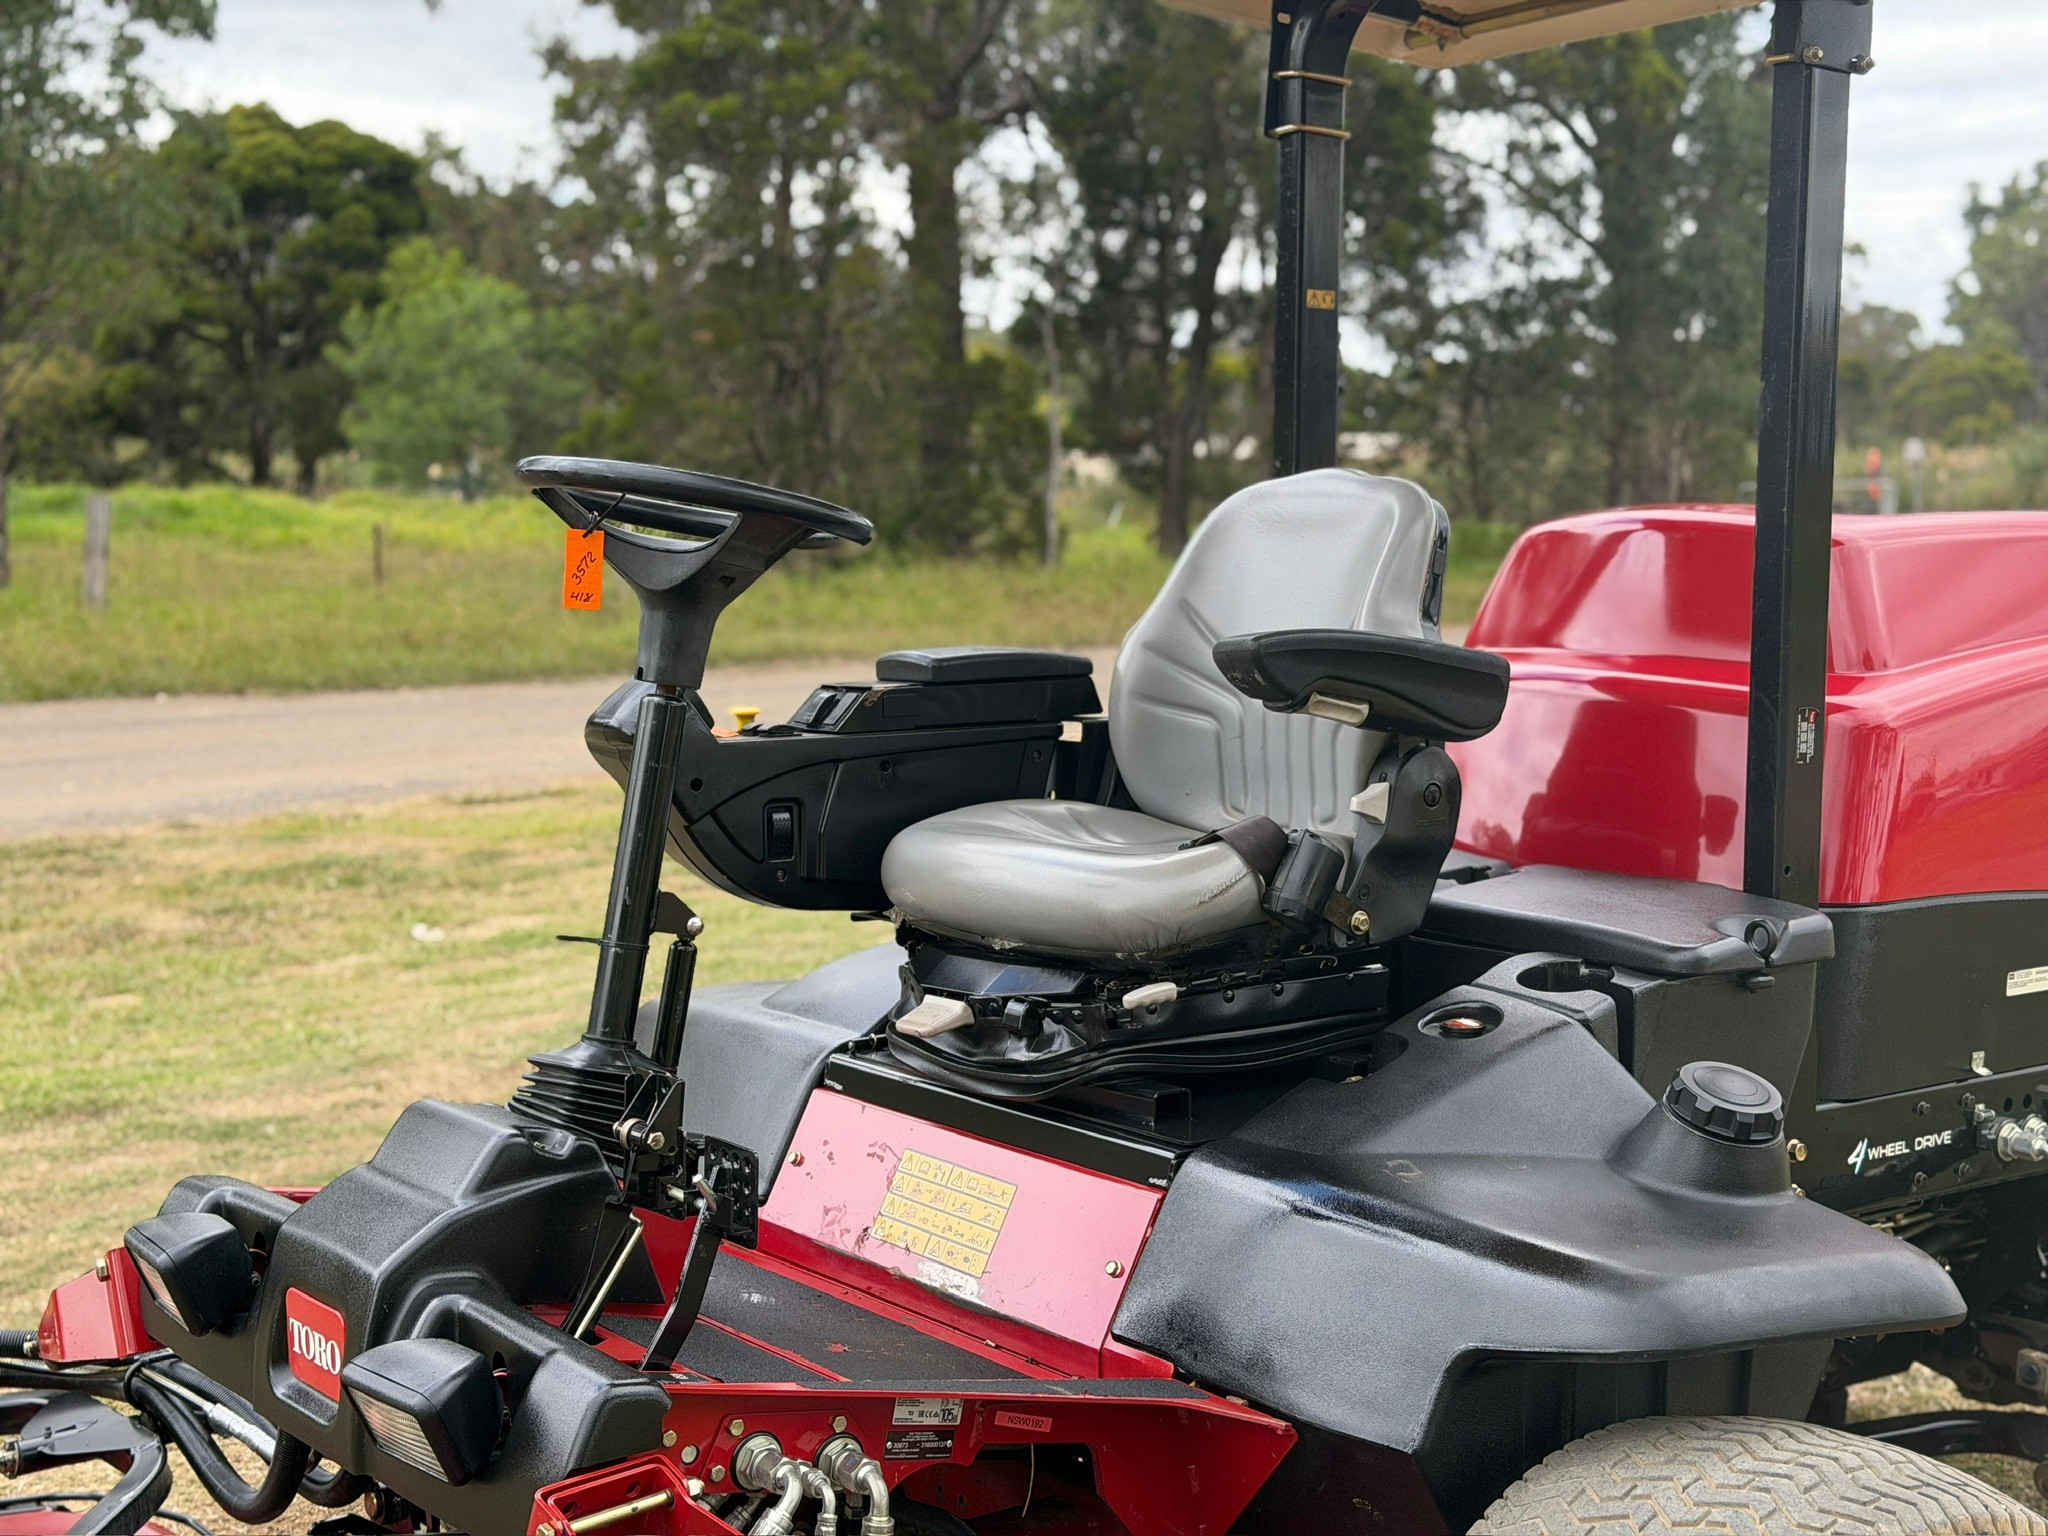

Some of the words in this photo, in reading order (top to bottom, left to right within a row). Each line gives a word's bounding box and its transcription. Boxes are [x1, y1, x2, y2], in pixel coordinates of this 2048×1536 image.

[571, 551, 597, 586] 3572
[1847, 1137, 1868, 1175] 4
[1867, 1140, 1911, 1161] WHEEL
[1914, 1130, 1952, 1151] DRIVE
[289, 1316, 341, 1375] TORO
[940, 1407, 955, 1422] 105
[1007, 1415, 1045, 1429] NSW0192
